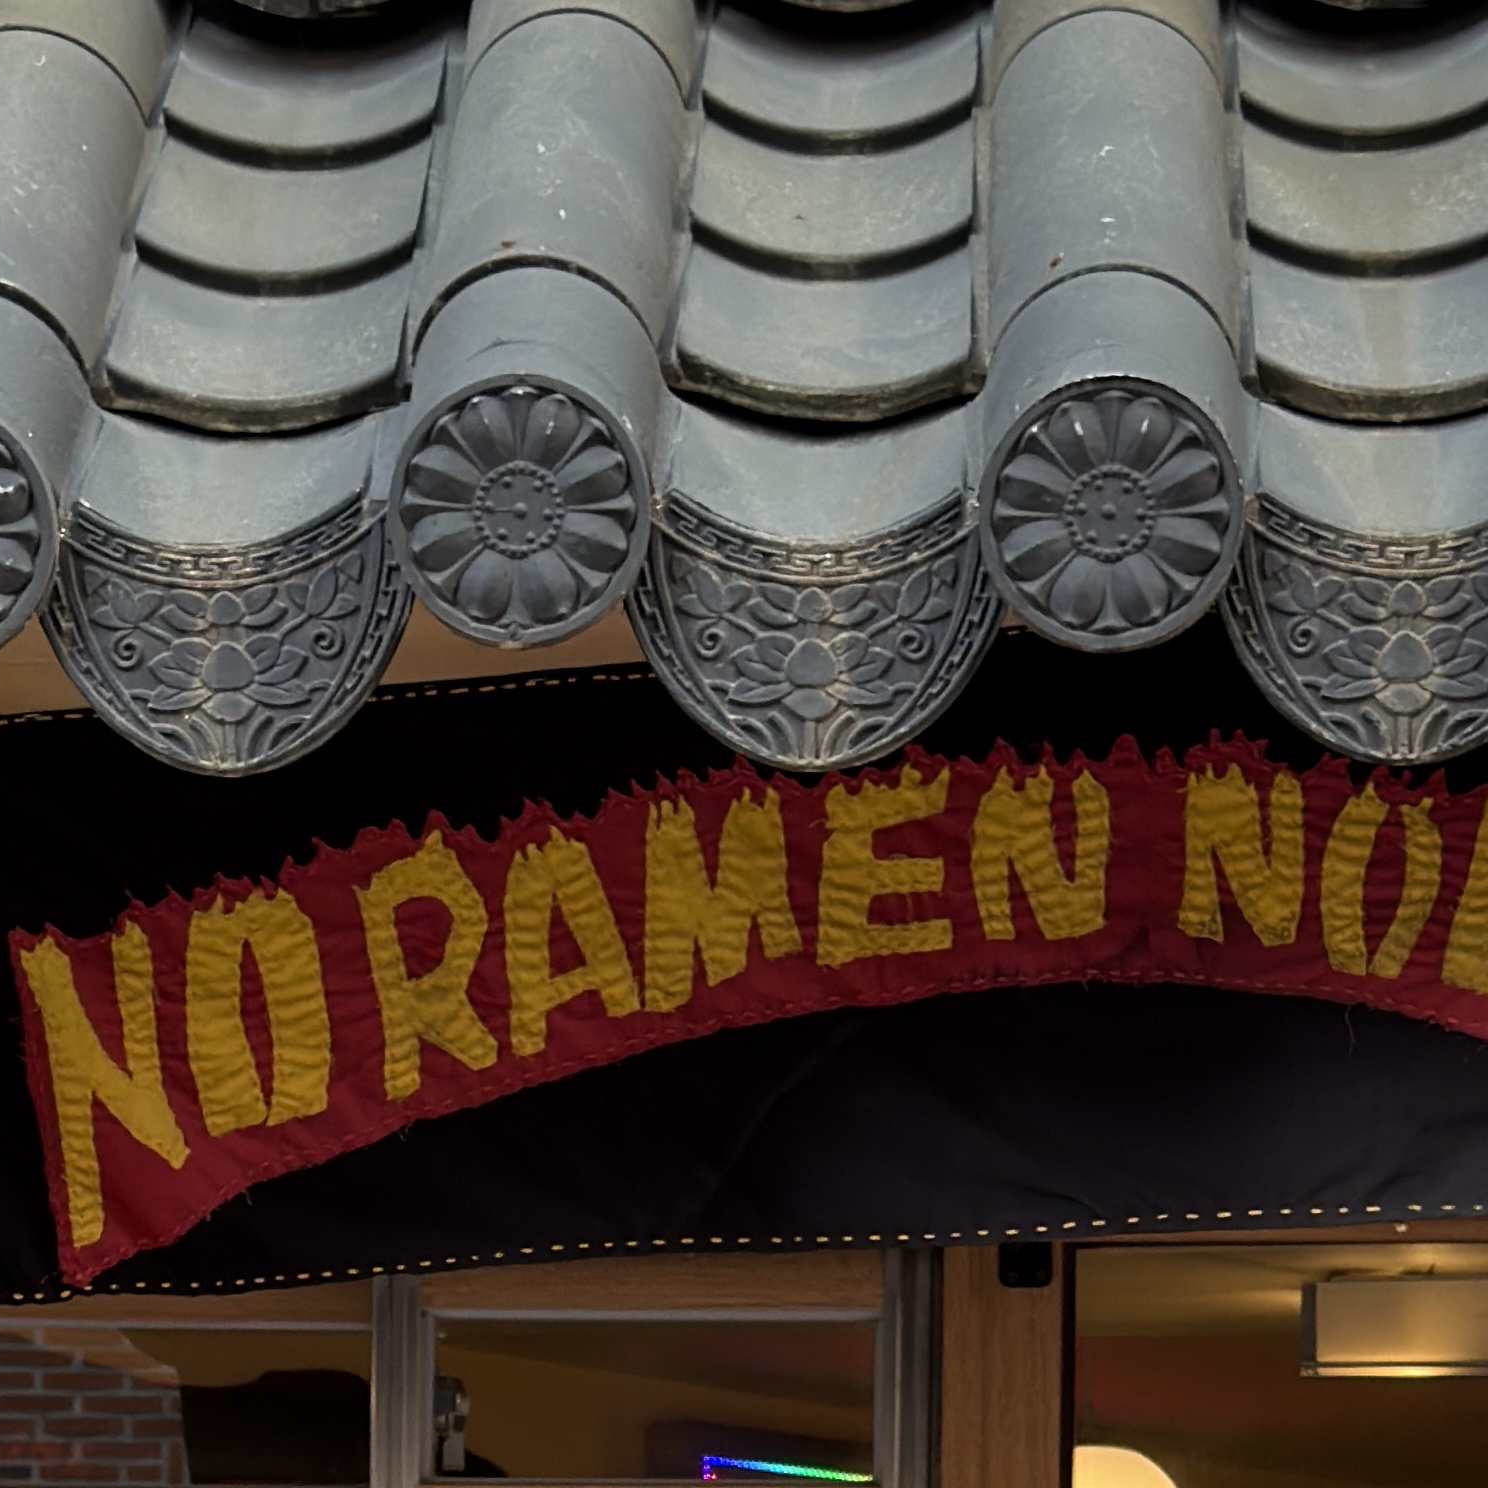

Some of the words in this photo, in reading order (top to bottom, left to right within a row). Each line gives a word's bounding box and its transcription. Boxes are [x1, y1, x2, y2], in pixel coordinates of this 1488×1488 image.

[20, 888, 332, 1248] NO
[353, 764, 1110, 1101] RAMEN
[1178, 764, 1442, 978] NO
